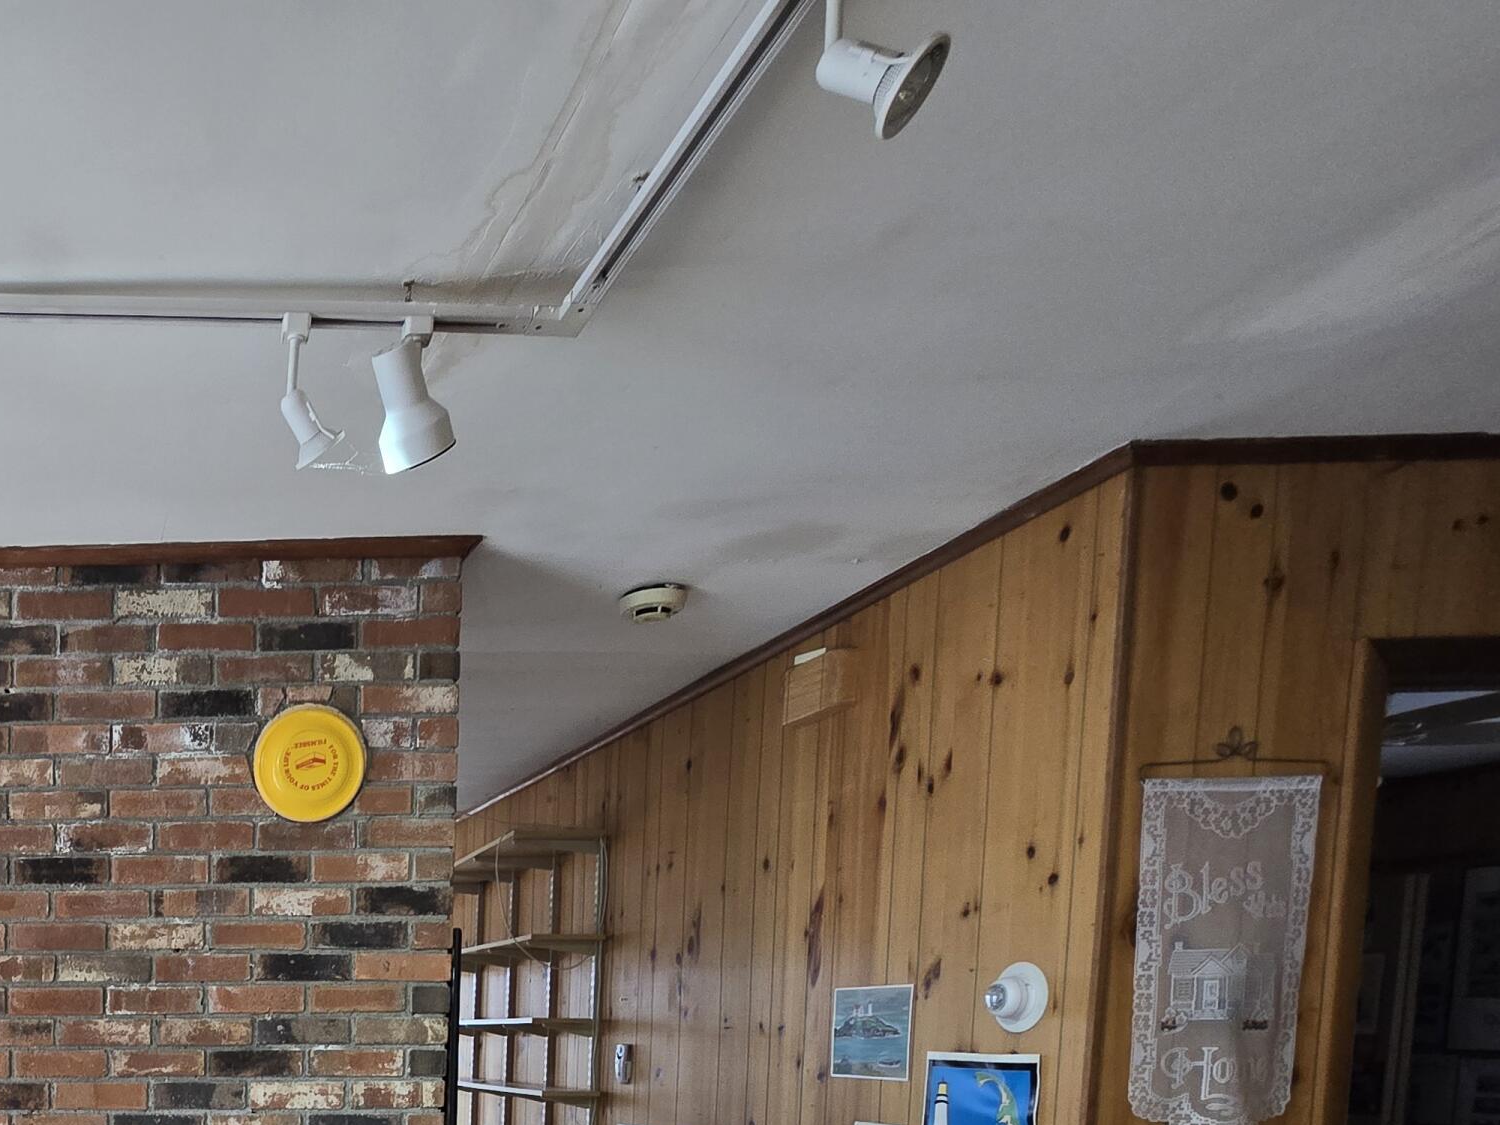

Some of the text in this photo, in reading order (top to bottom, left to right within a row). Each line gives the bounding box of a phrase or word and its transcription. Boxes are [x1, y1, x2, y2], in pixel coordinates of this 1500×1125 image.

[330, 761, 339, 776] THE
[284, 768, 299, 787] YOUR
[311, 776, 332, 791] TIMES
[299, 783, 310, 791] OF
[1162, 860, 1264, 930] Bless
